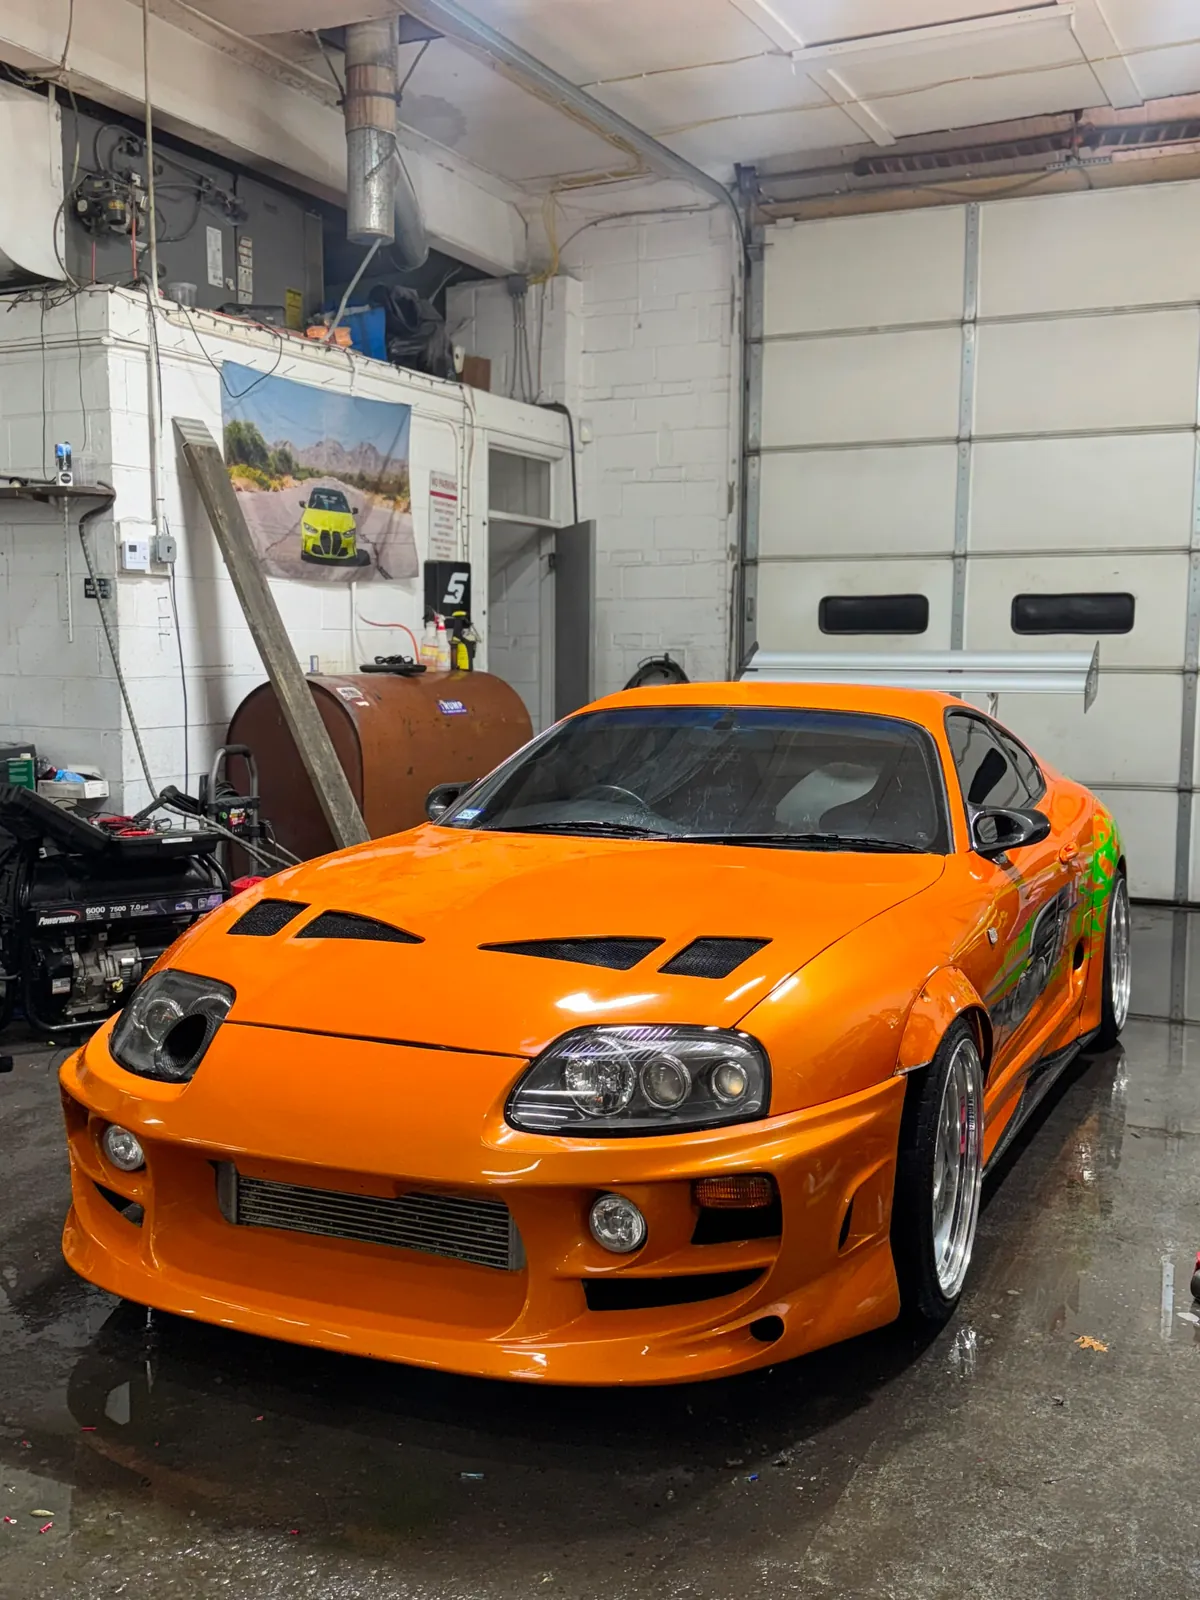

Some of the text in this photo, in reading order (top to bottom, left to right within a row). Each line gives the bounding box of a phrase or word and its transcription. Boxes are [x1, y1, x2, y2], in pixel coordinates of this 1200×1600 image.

[85, 906, 106, 914] 6000
[109, 905, 127, 913] 7500
[38, 915, 77, 926] Powermate
